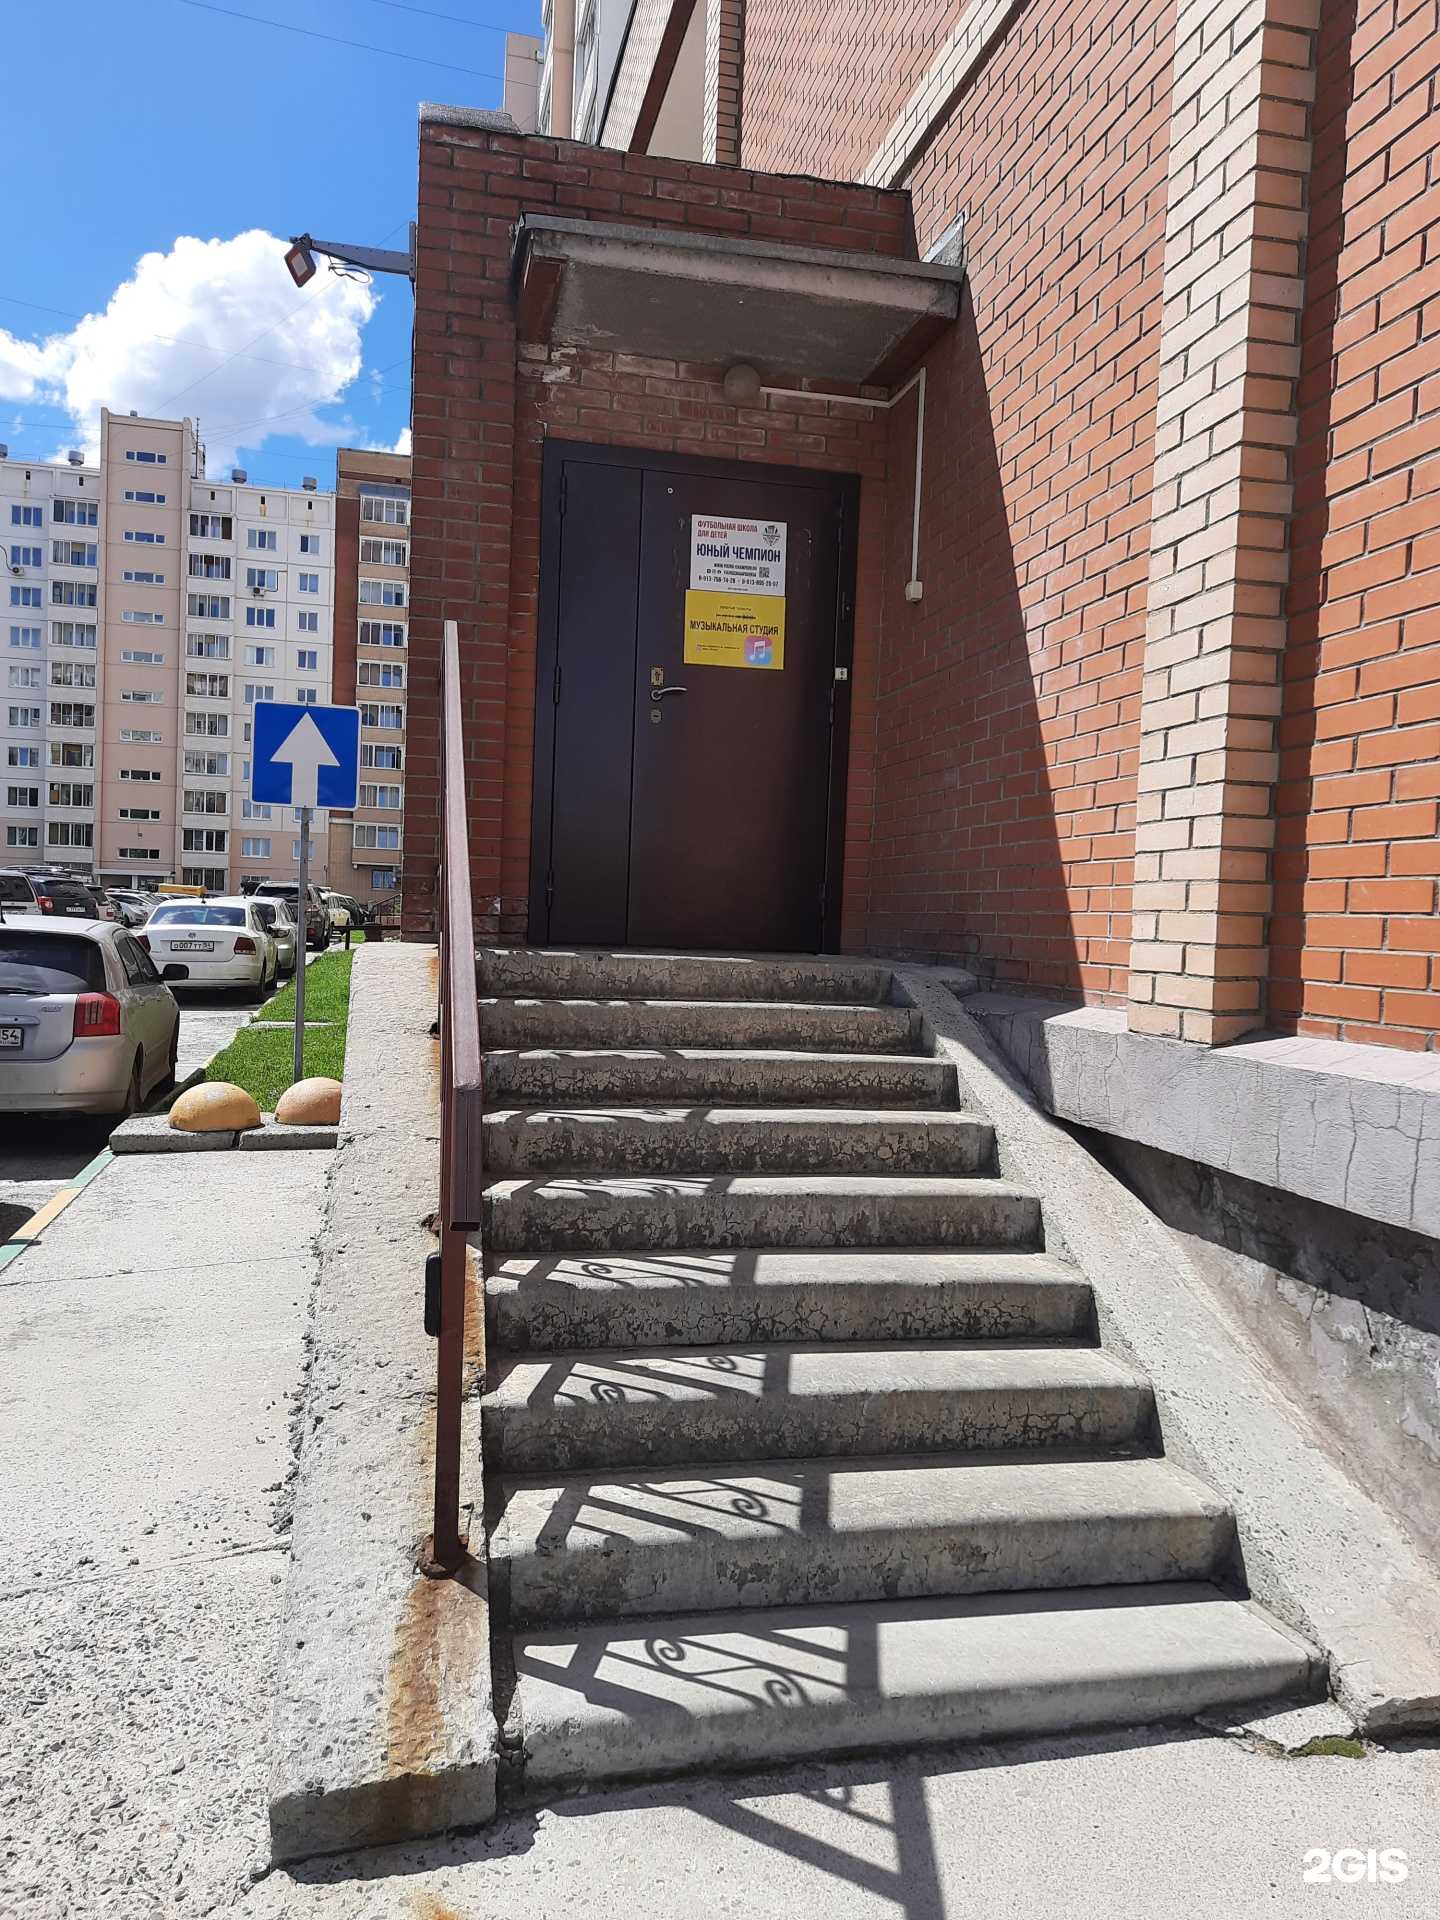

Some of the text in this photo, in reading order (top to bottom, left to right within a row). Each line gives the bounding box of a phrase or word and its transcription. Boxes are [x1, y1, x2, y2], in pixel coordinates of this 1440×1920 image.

[697, 520, 758, 533] ФУТБОЛЬНАЯ ШКОЛА
[697, 529, 728, 539] ДЛЯ ДЕТЕЙ
[696, 543, 781, 562] ЮНЫЙ ЧЕМПИОН
[689, 620, 779, 636] МУЗЫКАЛЬНАЯ СТУДИЯ
